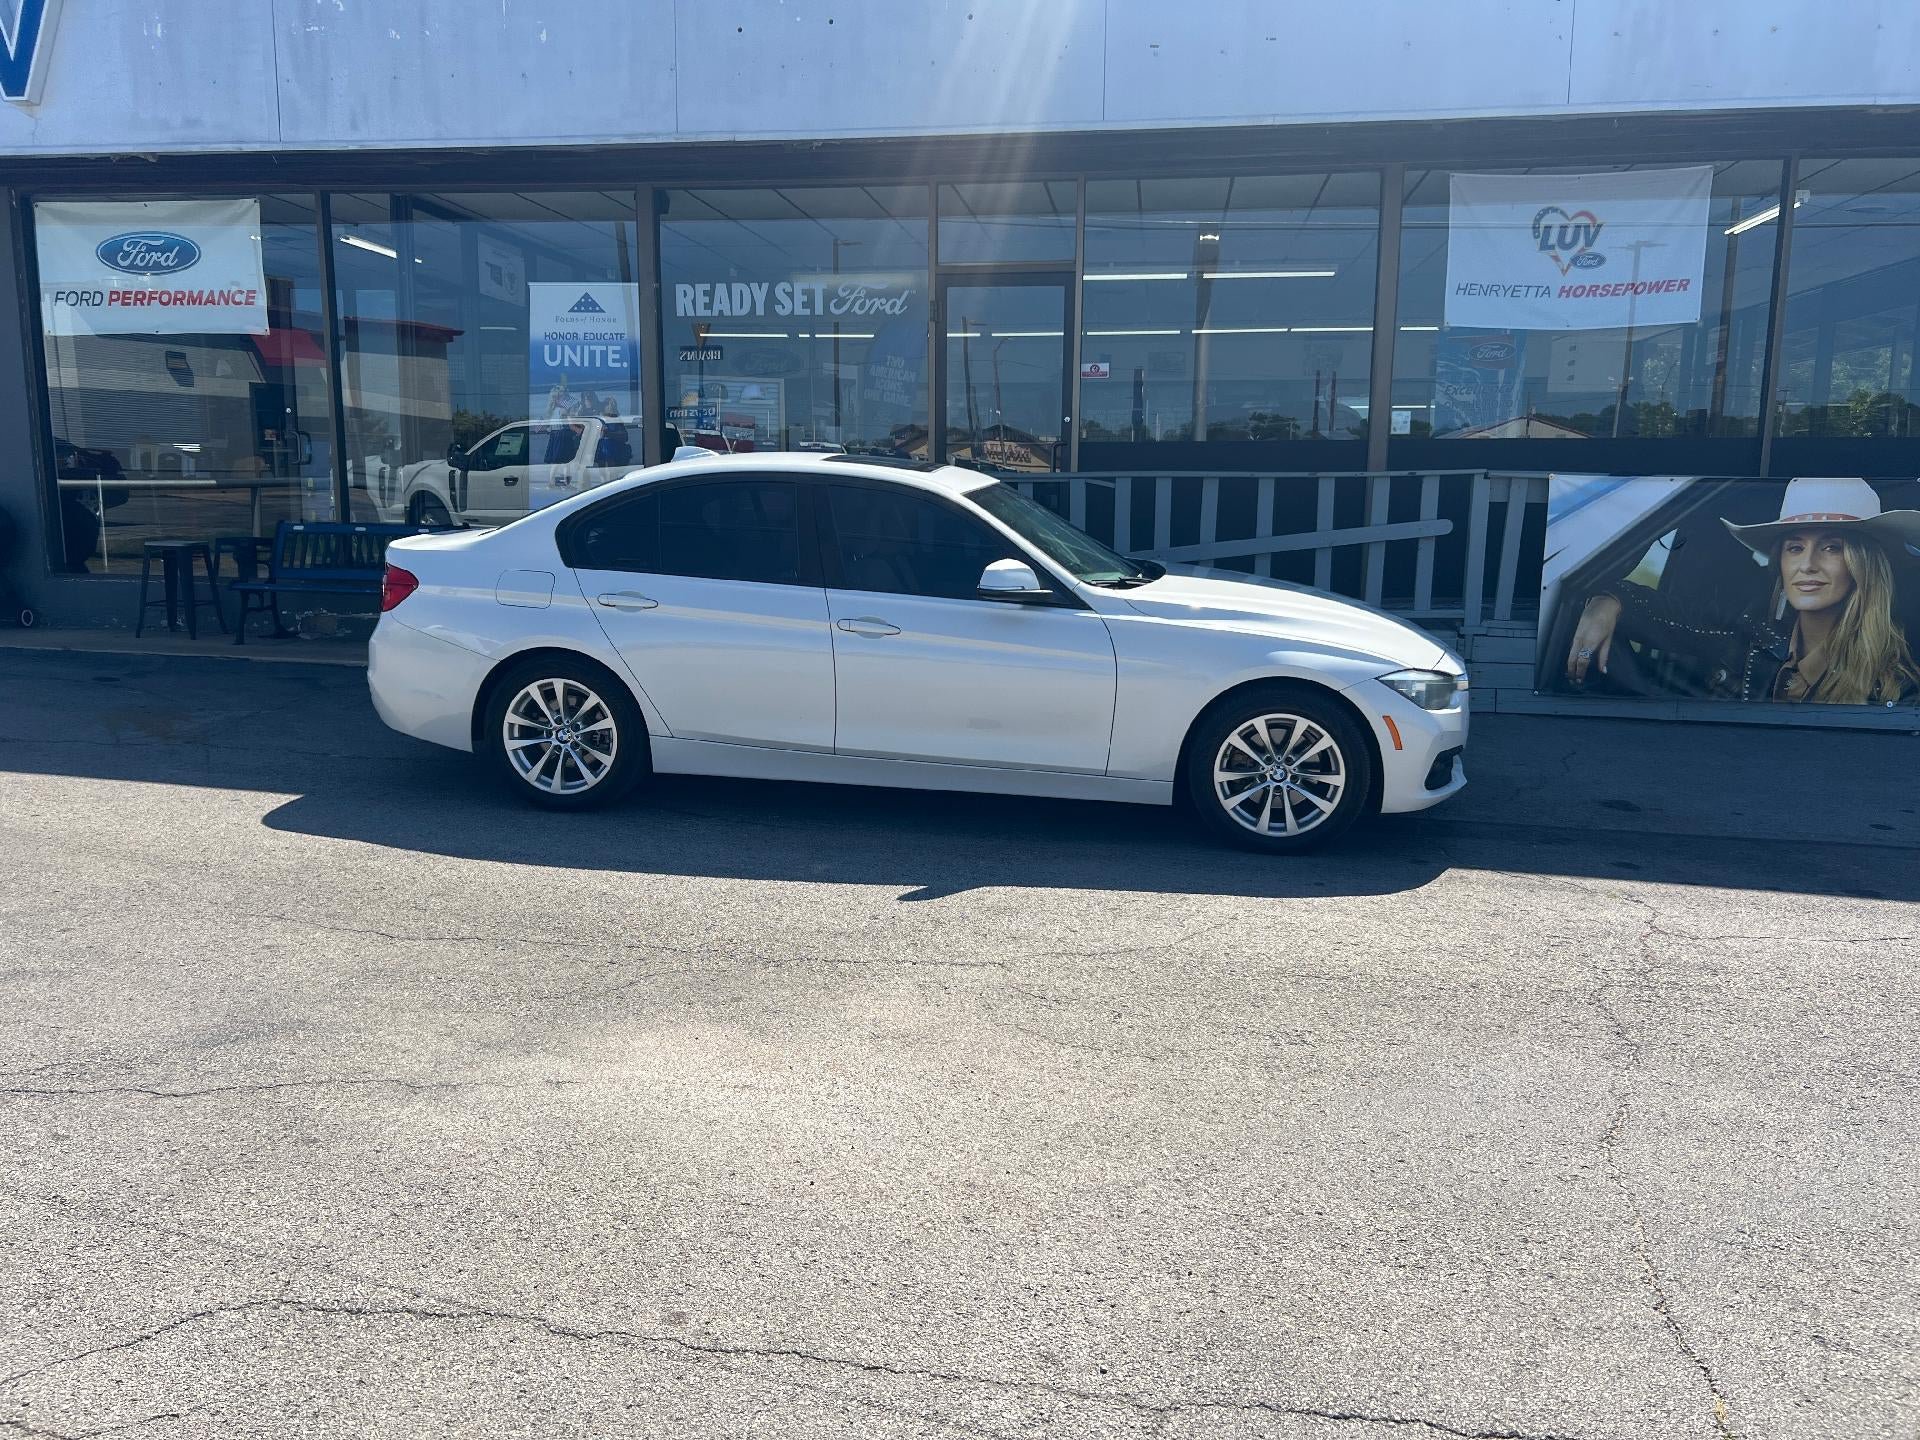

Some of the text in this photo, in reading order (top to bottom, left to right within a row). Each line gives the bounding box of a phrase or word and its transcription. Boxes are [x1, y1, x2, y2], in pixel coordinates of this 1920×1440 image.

[1539, 223, 1604, 251] LUV
[116, 238, 180, 268] Ford
[54, 289, 257, 307] FORD PERFORMANCE
[675, 281, 912, 317] READY SET Ford
[1455, 278, 1691, 298] HENRYETTA HORSEPOWER
[543, 344, 628, 368] UNITE.
